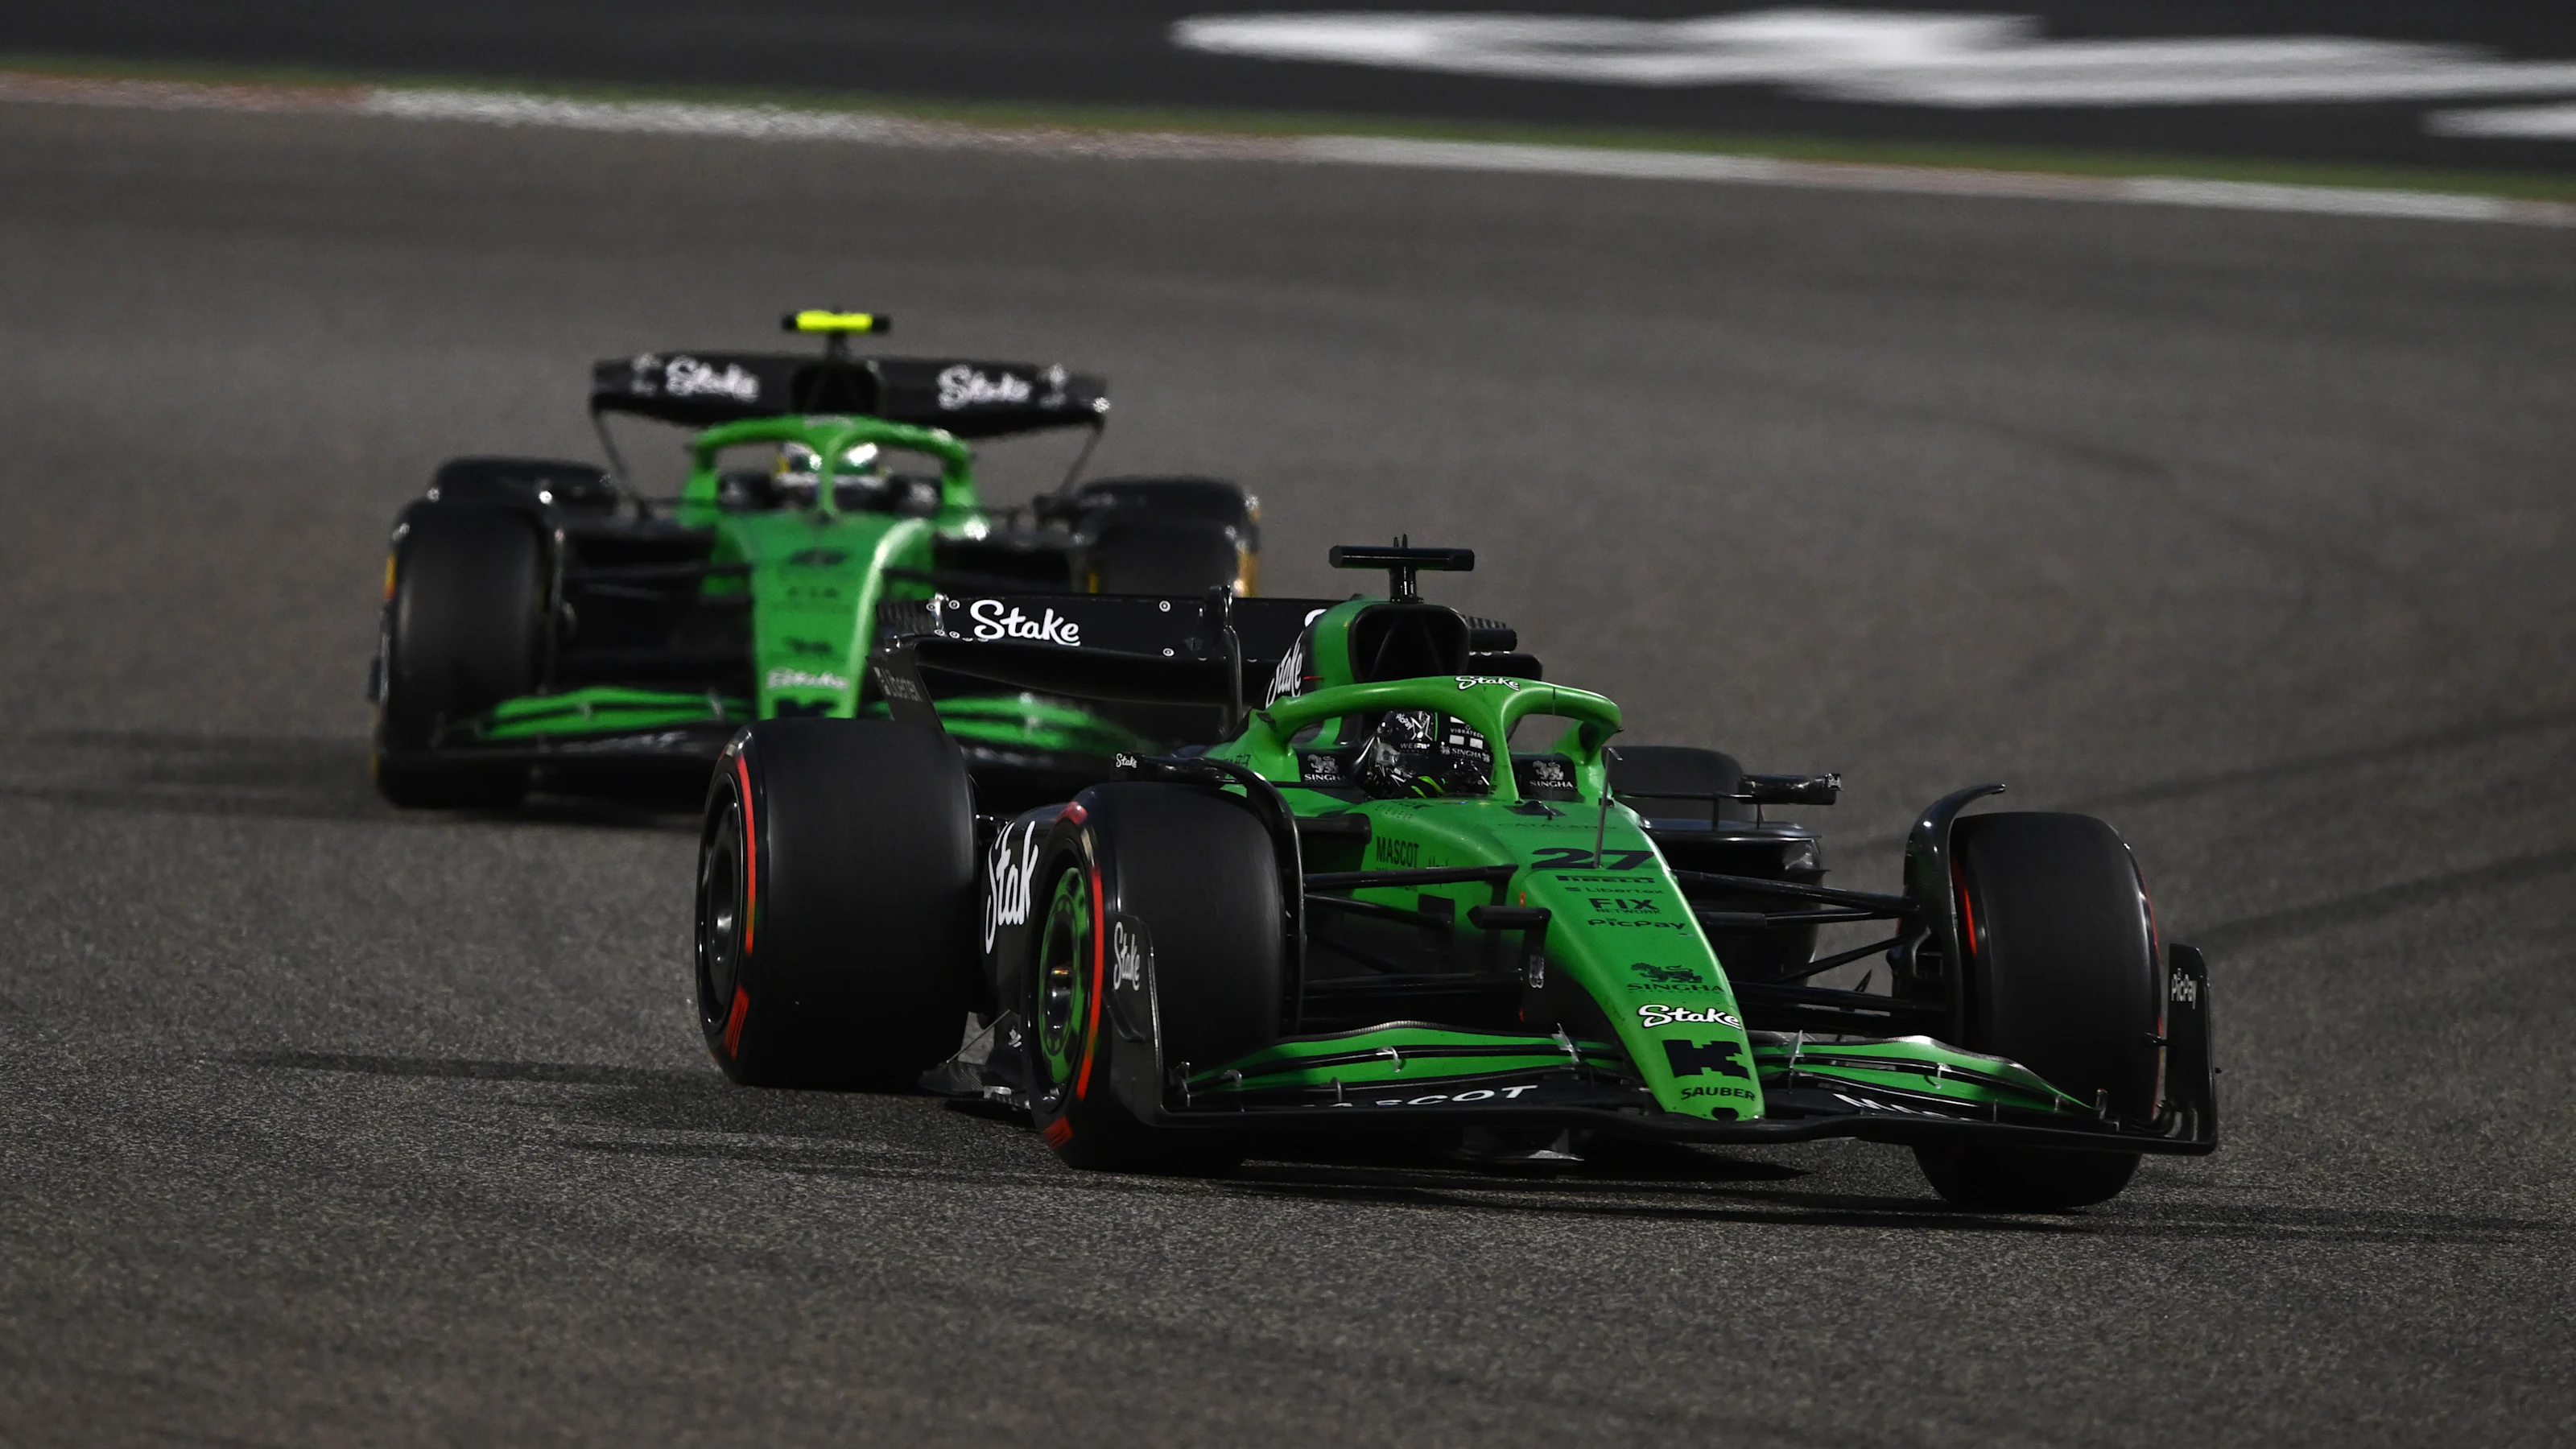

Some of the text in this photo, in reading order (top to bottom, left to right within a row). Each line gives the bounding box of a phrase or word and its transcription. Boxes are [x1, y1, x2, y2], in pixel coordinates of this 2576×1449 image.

[970, 600, 1081, 646] Stake
[1455, 675, 1520, 691] Stake
[1451, 747, 1482, 758] SINGHA
[1116, 753, 1137, 769] Stake
[1530, 780, 1574, 788] SINGHA
[1376, 836, 1420, 869] MASCOT
[1531, 848, 1655, 871] 27
[985, 820, 1039, 955] Stak
[1588, 898, 1659, 910] FIX
[1587, 919, 1686, 930] PicPay
[1113, 921, 1141, 991] Stake
[1627, 984, 1726, 993] SINGHA
[1637, 1004, 1743, 1030] Stake
[1681, 1087, 1756, 1102] SAUBER
